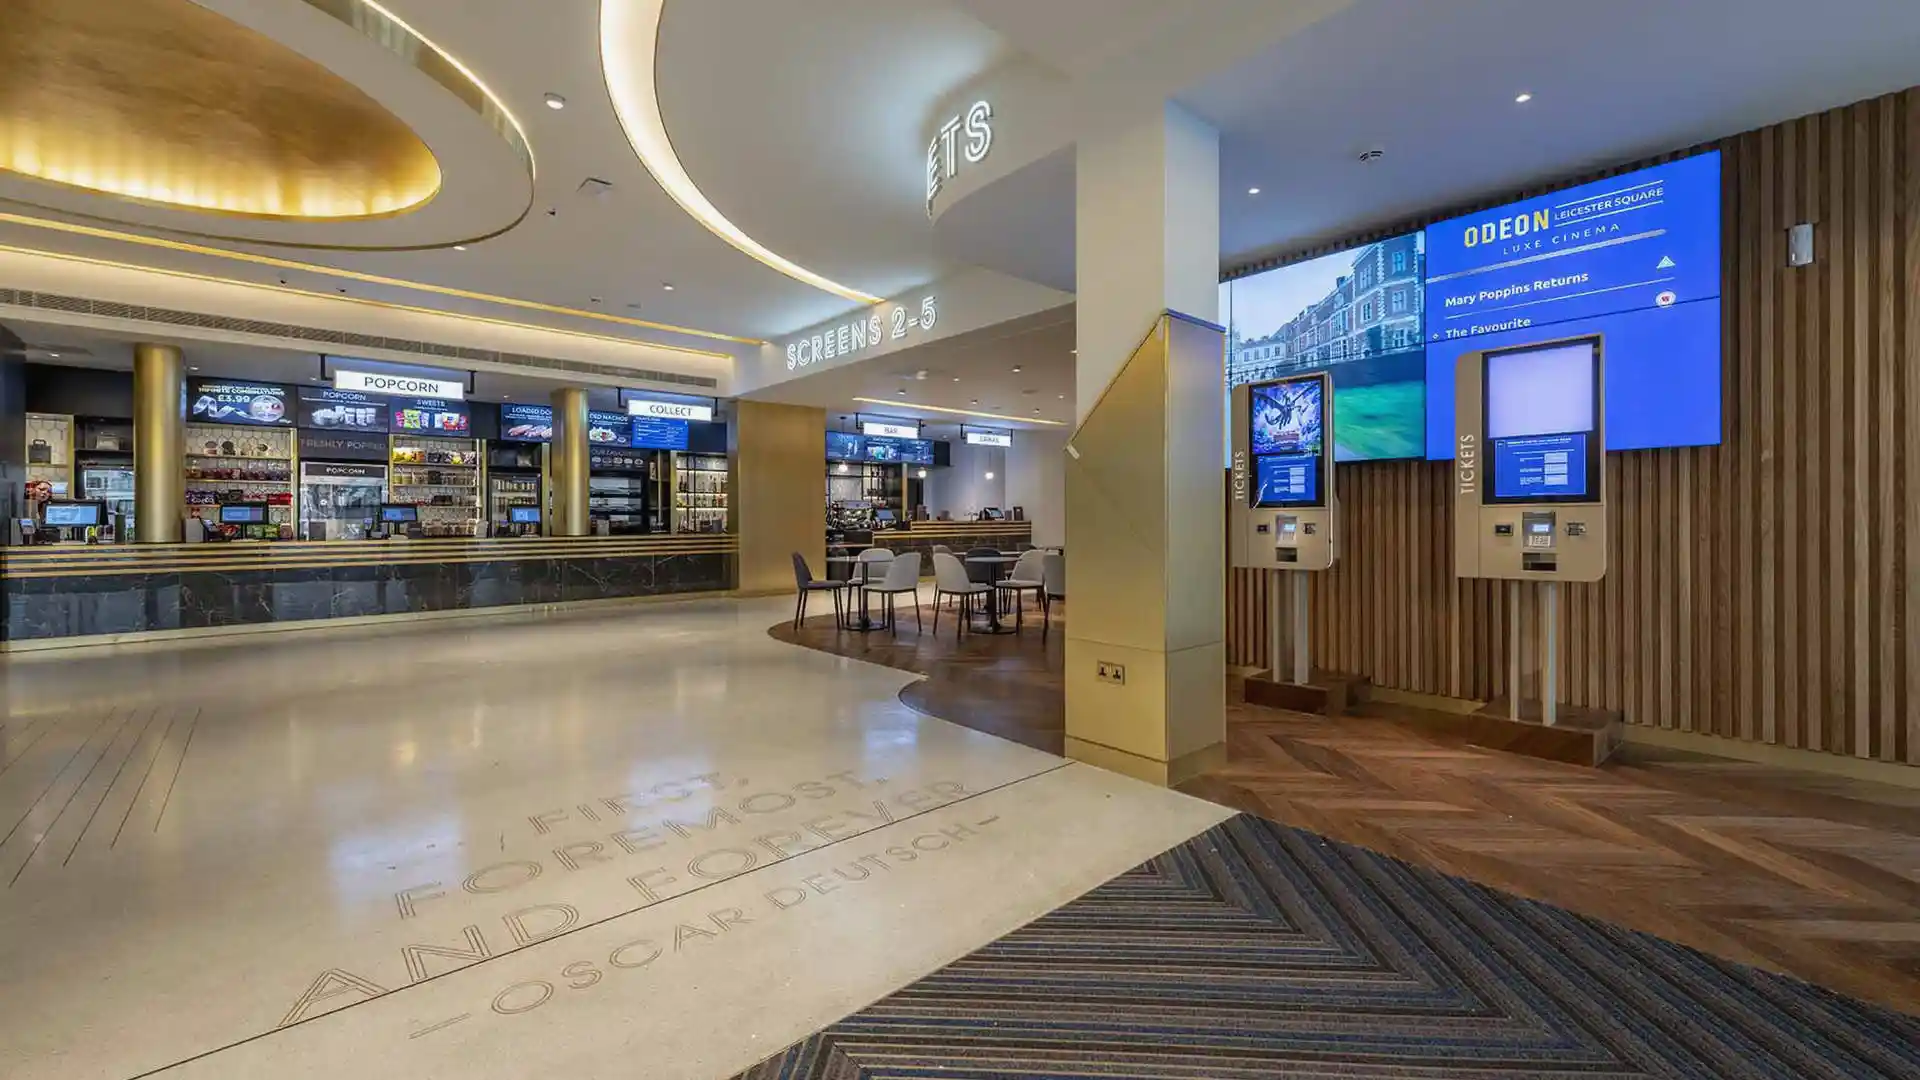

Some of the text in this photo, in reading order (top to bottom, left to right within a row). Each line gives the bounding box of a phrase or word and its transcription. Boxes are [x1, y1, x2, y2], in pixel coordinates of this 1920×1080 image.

[926, 100, 993, 216] ETS
[1553, 187, 1664, 221] LEICESTER SQUARE
[1464, 208, 1550, 248] ODEON
[1503, 223, 1621, 255] LUXE CINEMA
[1444, 272, 1589, 309] Mary Poppins Returns
[786, 295, 938, 371] SCREENS 2-5
[1445, 317, 1532, 339] The Favourite
[217, 394, 250, 403] £3.99
[322, 390, 367, 401] POPCORN
[364, 376, 440, 394] POPCORN
[602, 413, 628, 422] NACHOS
[649, 404, 693, 417] COLLECT
[325, 466, 366, 475] POPCORN
[1234, 449, 1246, 501] TICKETS
[1458, 433, 1475, 495] TICKETS
[275, 779, 979, 1028] AND FOREVER
